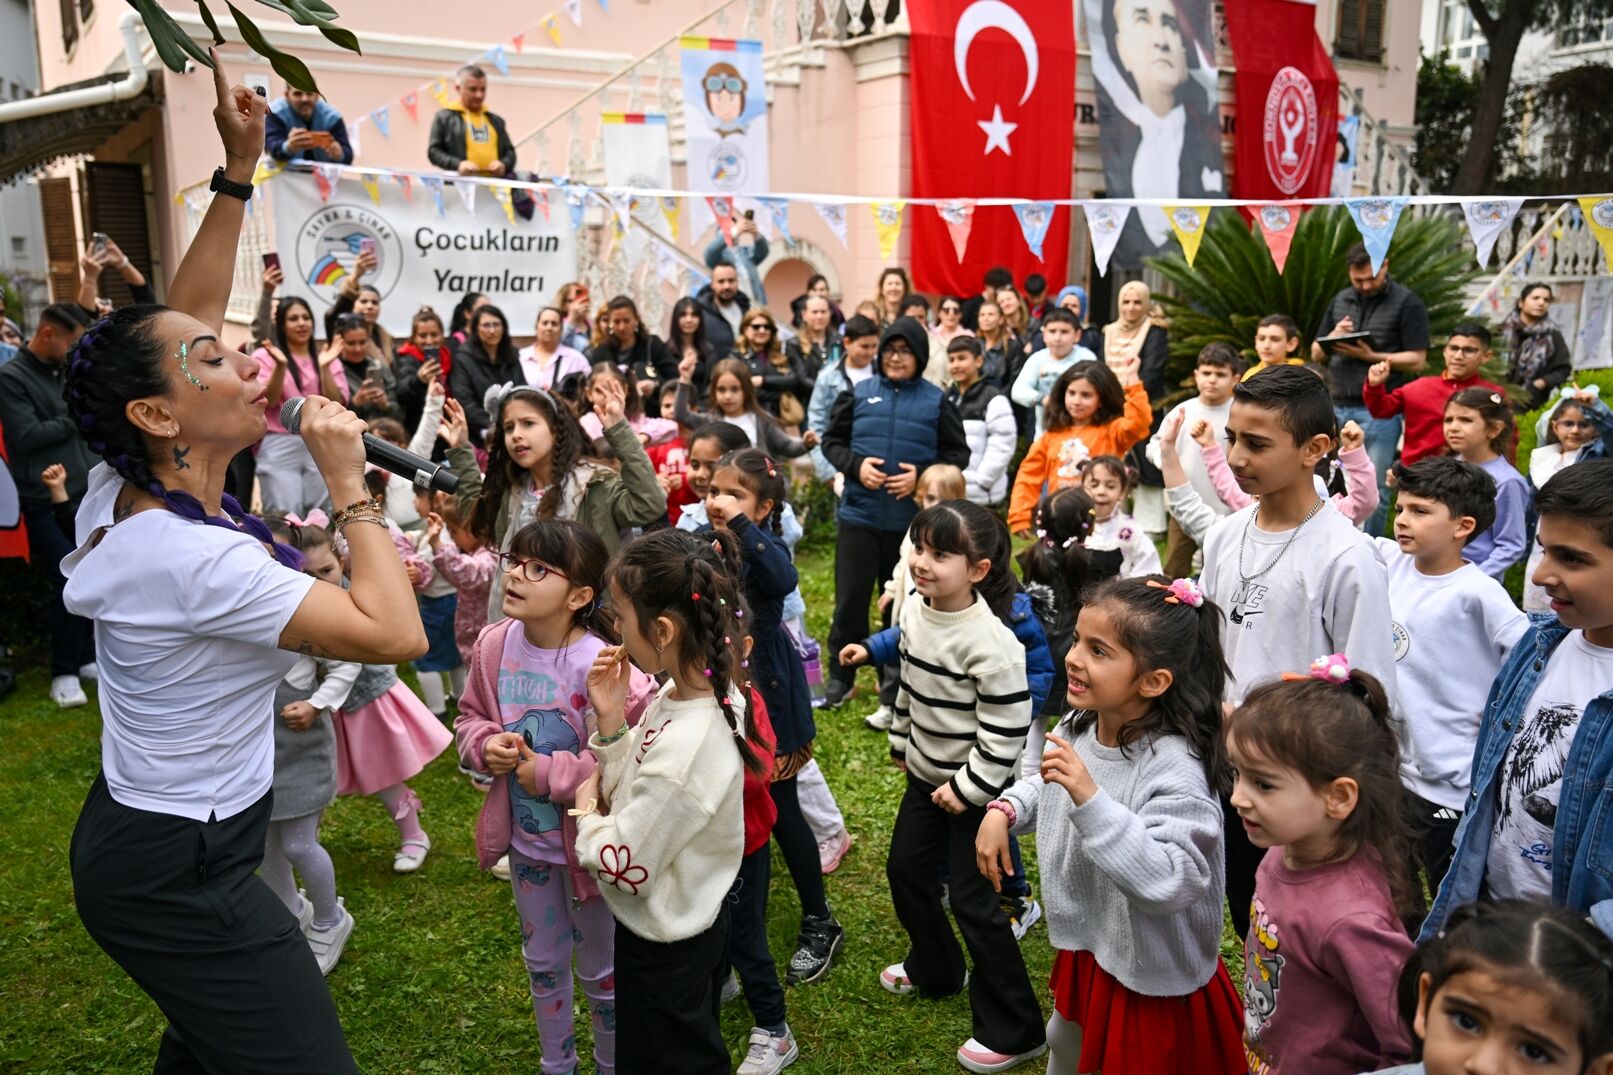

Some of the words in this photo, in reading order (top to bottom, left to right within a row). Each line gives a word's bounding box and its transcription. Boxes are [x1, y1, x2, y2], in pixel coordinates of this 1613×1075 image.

[415, 227, 559, 257] Çocukların
[434, 269, 544, 292] Yarınları
[499, 675, 548, 703] TITCH
